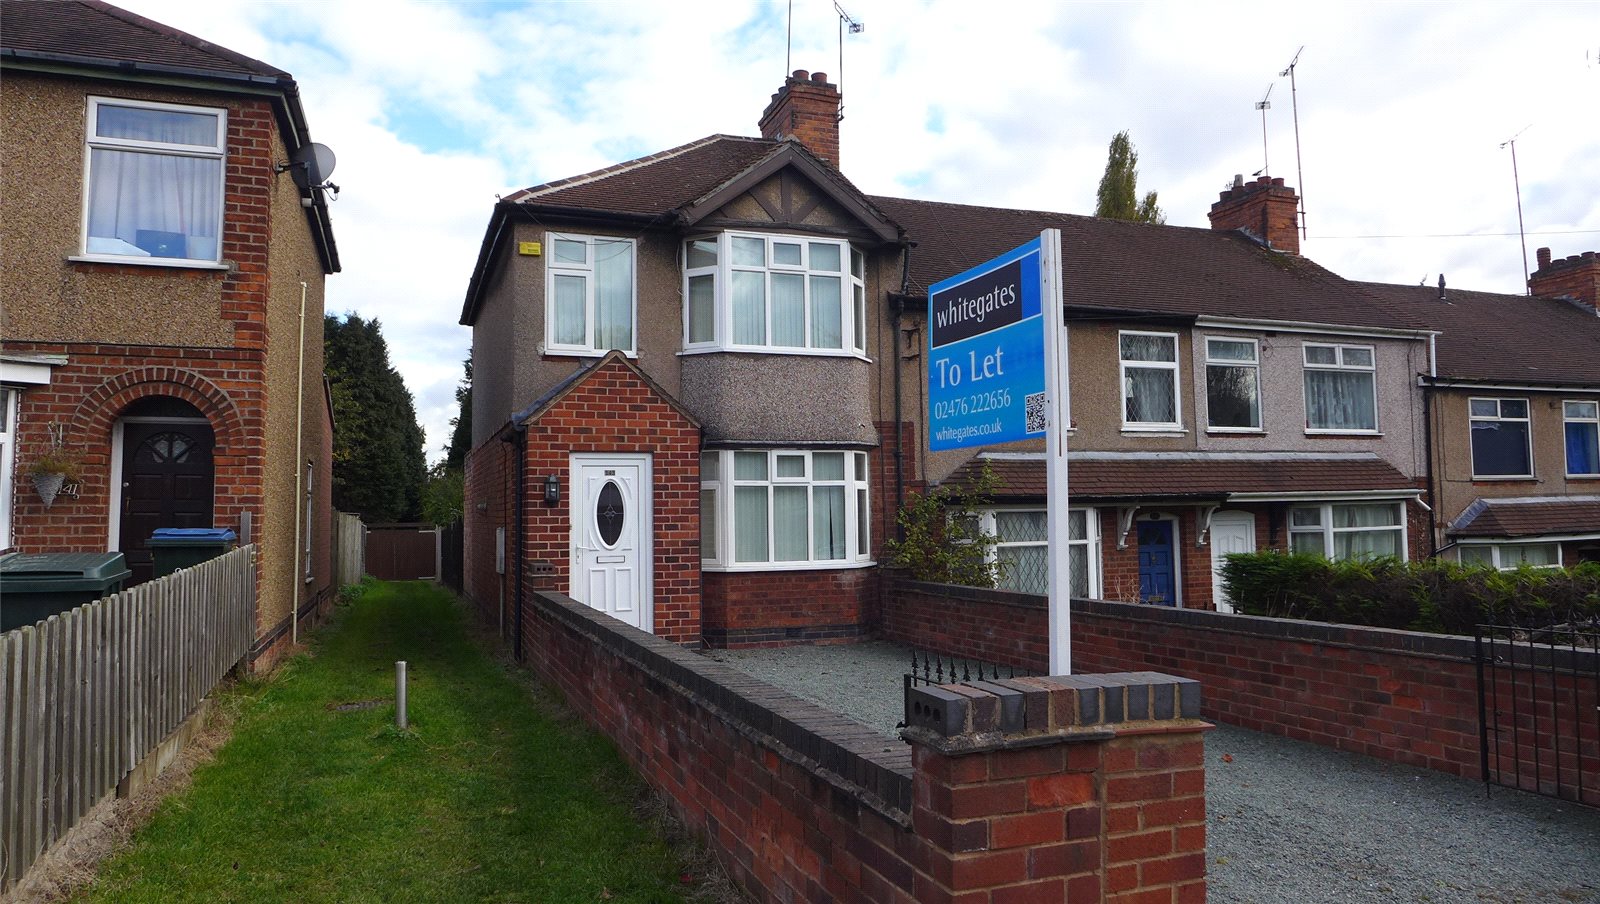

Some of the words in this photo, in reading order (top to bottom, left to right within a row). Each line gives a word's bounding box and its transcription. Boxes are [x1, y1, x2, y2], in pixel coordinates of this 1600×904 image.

[937, 284, 1016, 328] whitegates
[935, 358, 961, 389] To
[968, 345, 1004, 382] Let
[935, 397, 968, 419] 02476
[970, 388, 1011, 413] 222656
[935, 417, 1003, 442] whitegates.co.uk
